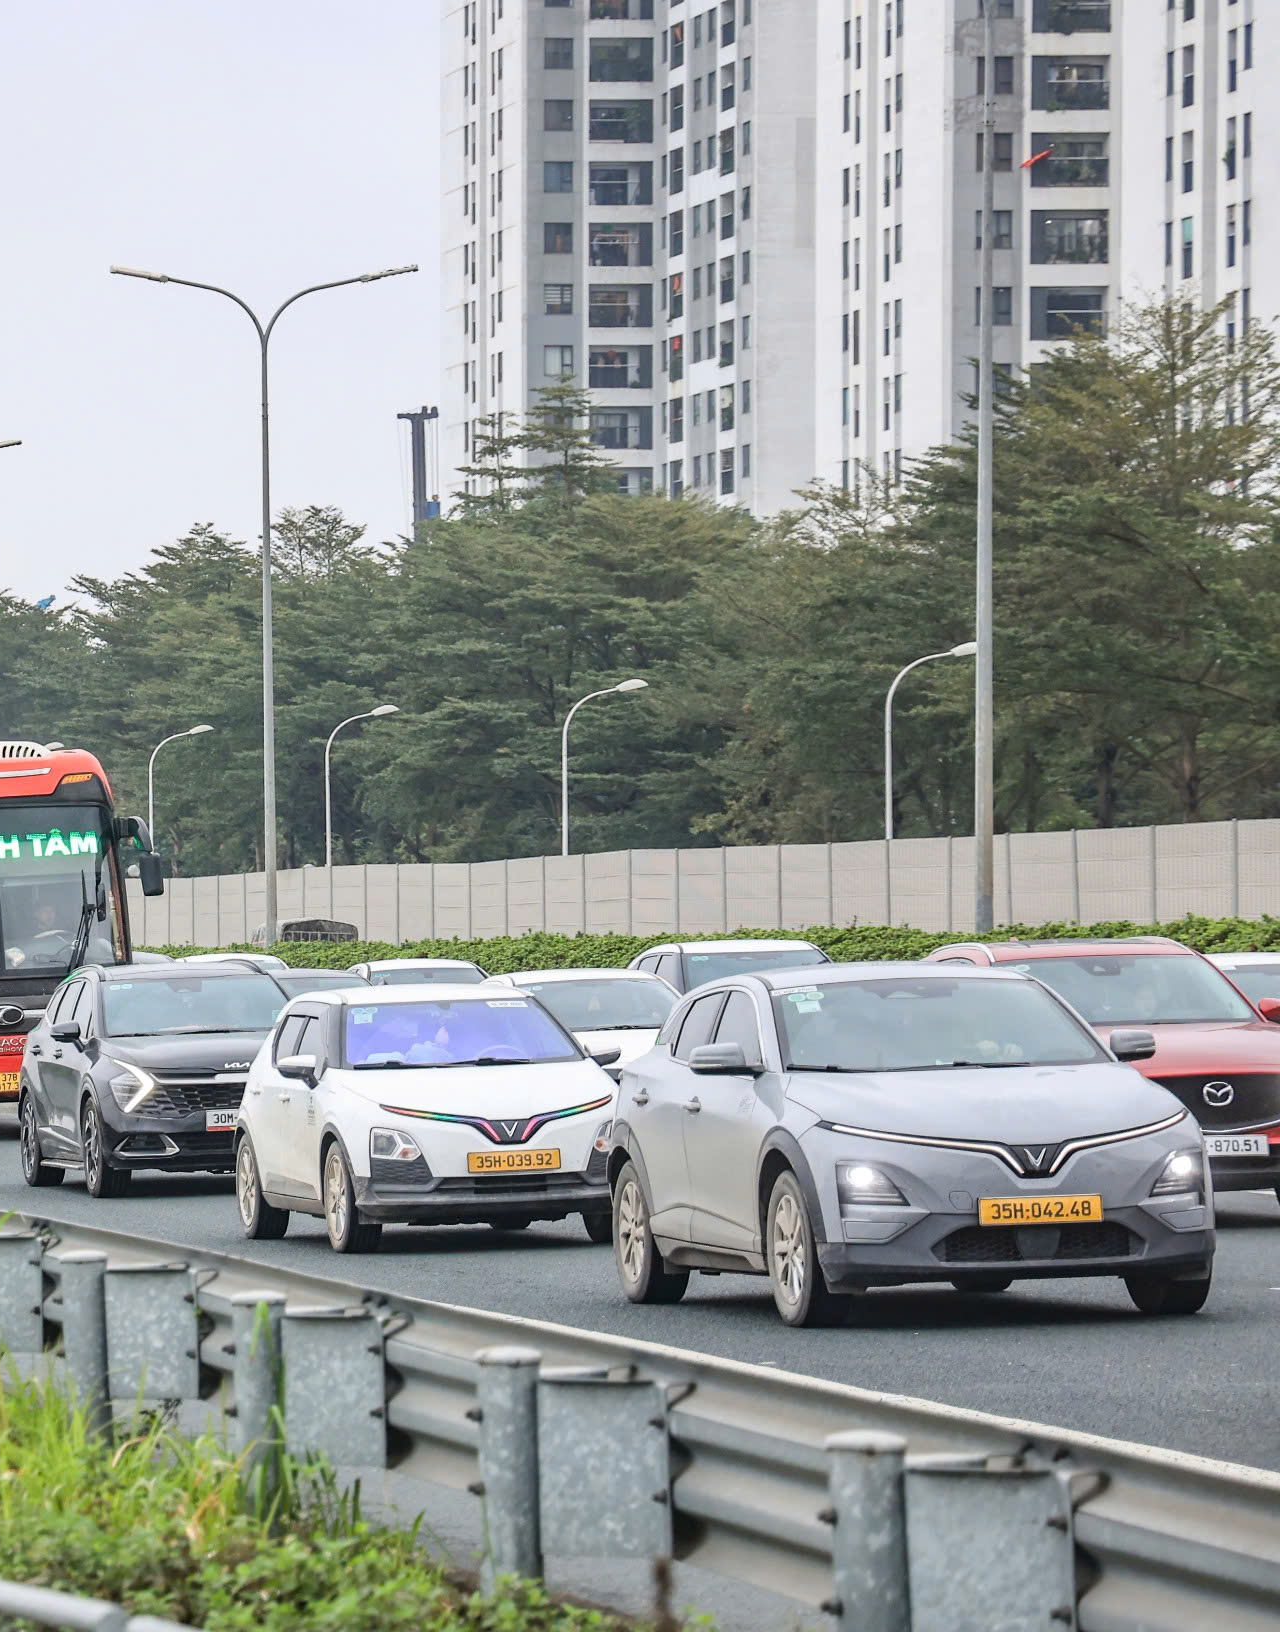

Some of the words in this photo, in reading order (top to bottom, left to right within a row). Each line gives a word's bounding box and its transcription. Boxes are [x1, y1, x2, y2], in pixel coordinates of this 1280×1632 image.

[25, 827, 99, 857] TÂM
[1, 1073, 18, 1082] 37B
[1205, 1139, 1259, 1152] -870.51
[476, 1153, 552, 1168] 35H-039.92
